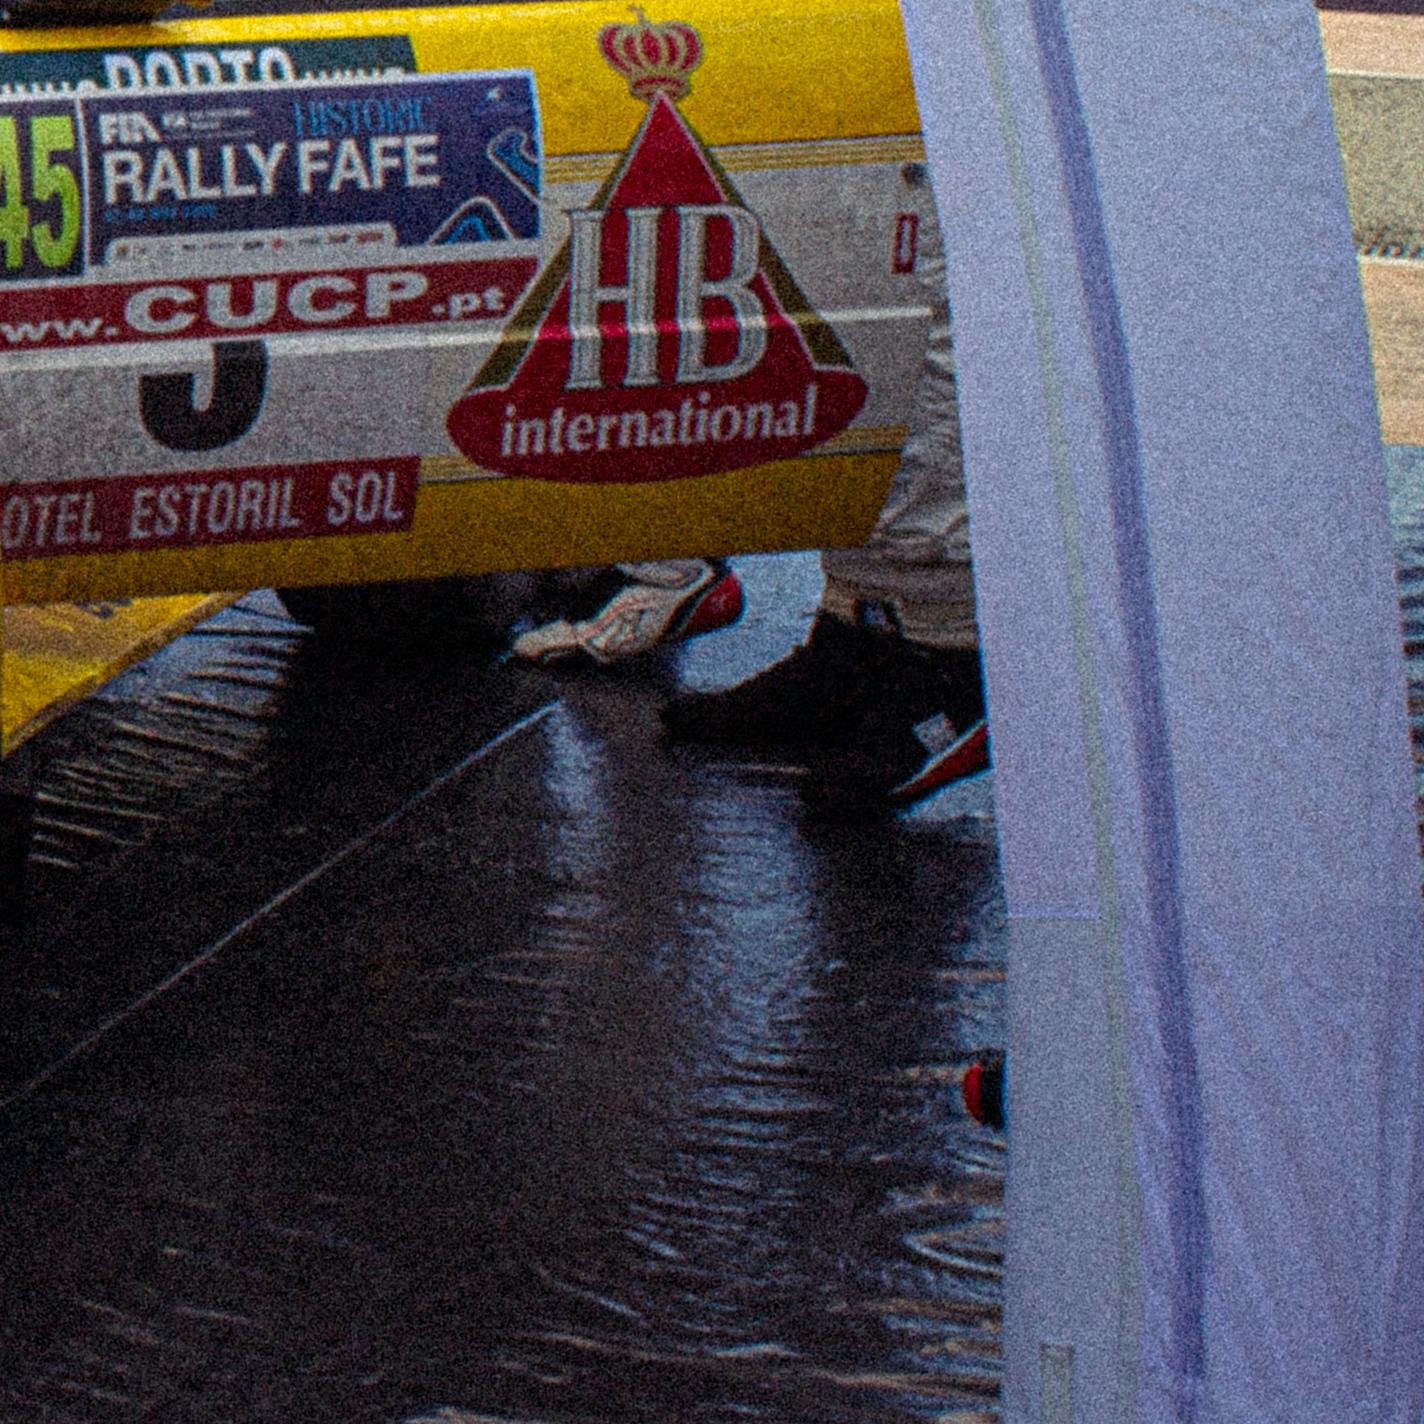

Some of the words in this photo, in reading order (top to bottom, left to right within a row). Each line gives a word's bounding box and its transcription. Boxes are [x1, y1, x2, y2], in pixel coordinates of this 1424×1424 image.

[293, 96, 433, 137] HISTORIC
[103, 141, 287, 204] RALLY
[297, 134, 440, 193] FAFE
[563, 203, 767, 391] HB
[500, 385, 818, 458] international
[128, 478, 300, 540] ESTORIL
[326, 471, 404, 526] SOL
